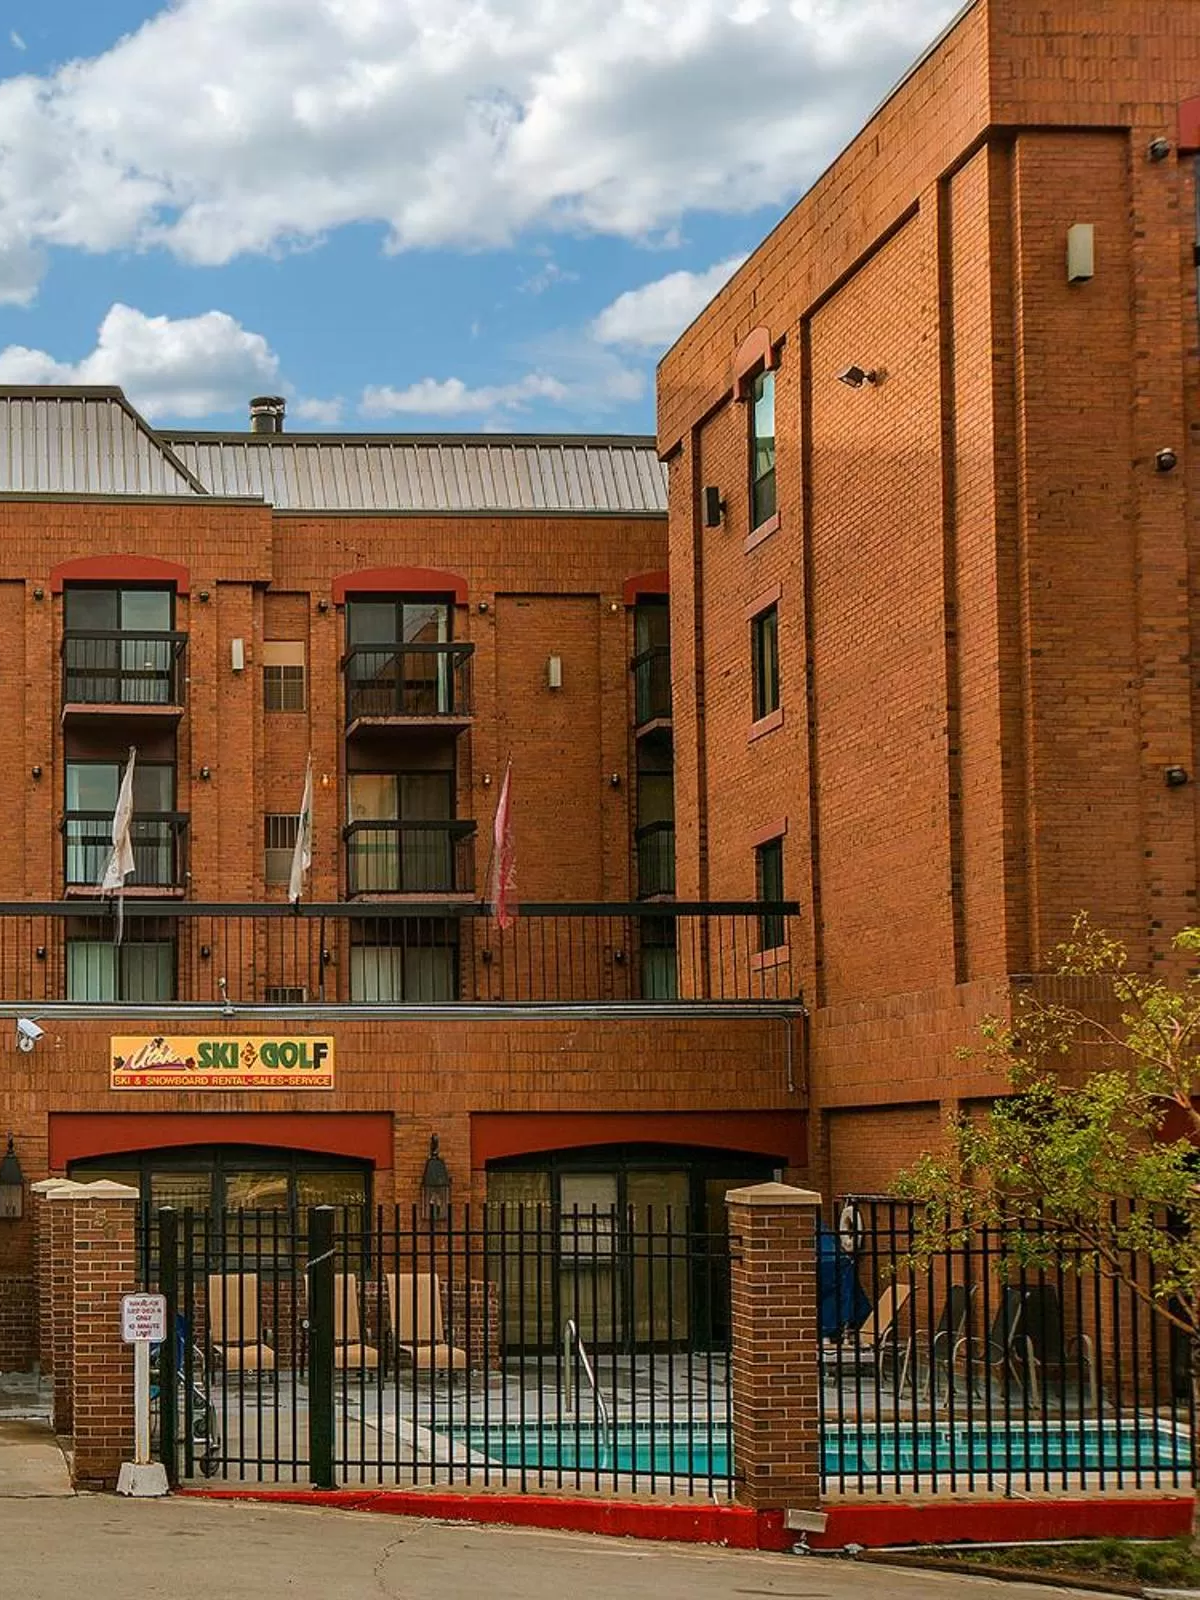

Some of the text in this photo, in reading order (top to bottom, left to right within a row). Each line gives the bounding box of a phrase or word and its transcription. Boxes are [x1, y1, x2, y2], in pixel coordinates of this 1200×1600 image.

[197, 1042, 239, 1069] SKI
[260, 1042, 328, 1069] GOLF
[114, 1077, 130, 1086] SKI
[134, 1077, 141, 1086] &
[146, 1077, 208, 1086] SNOWBOARD
